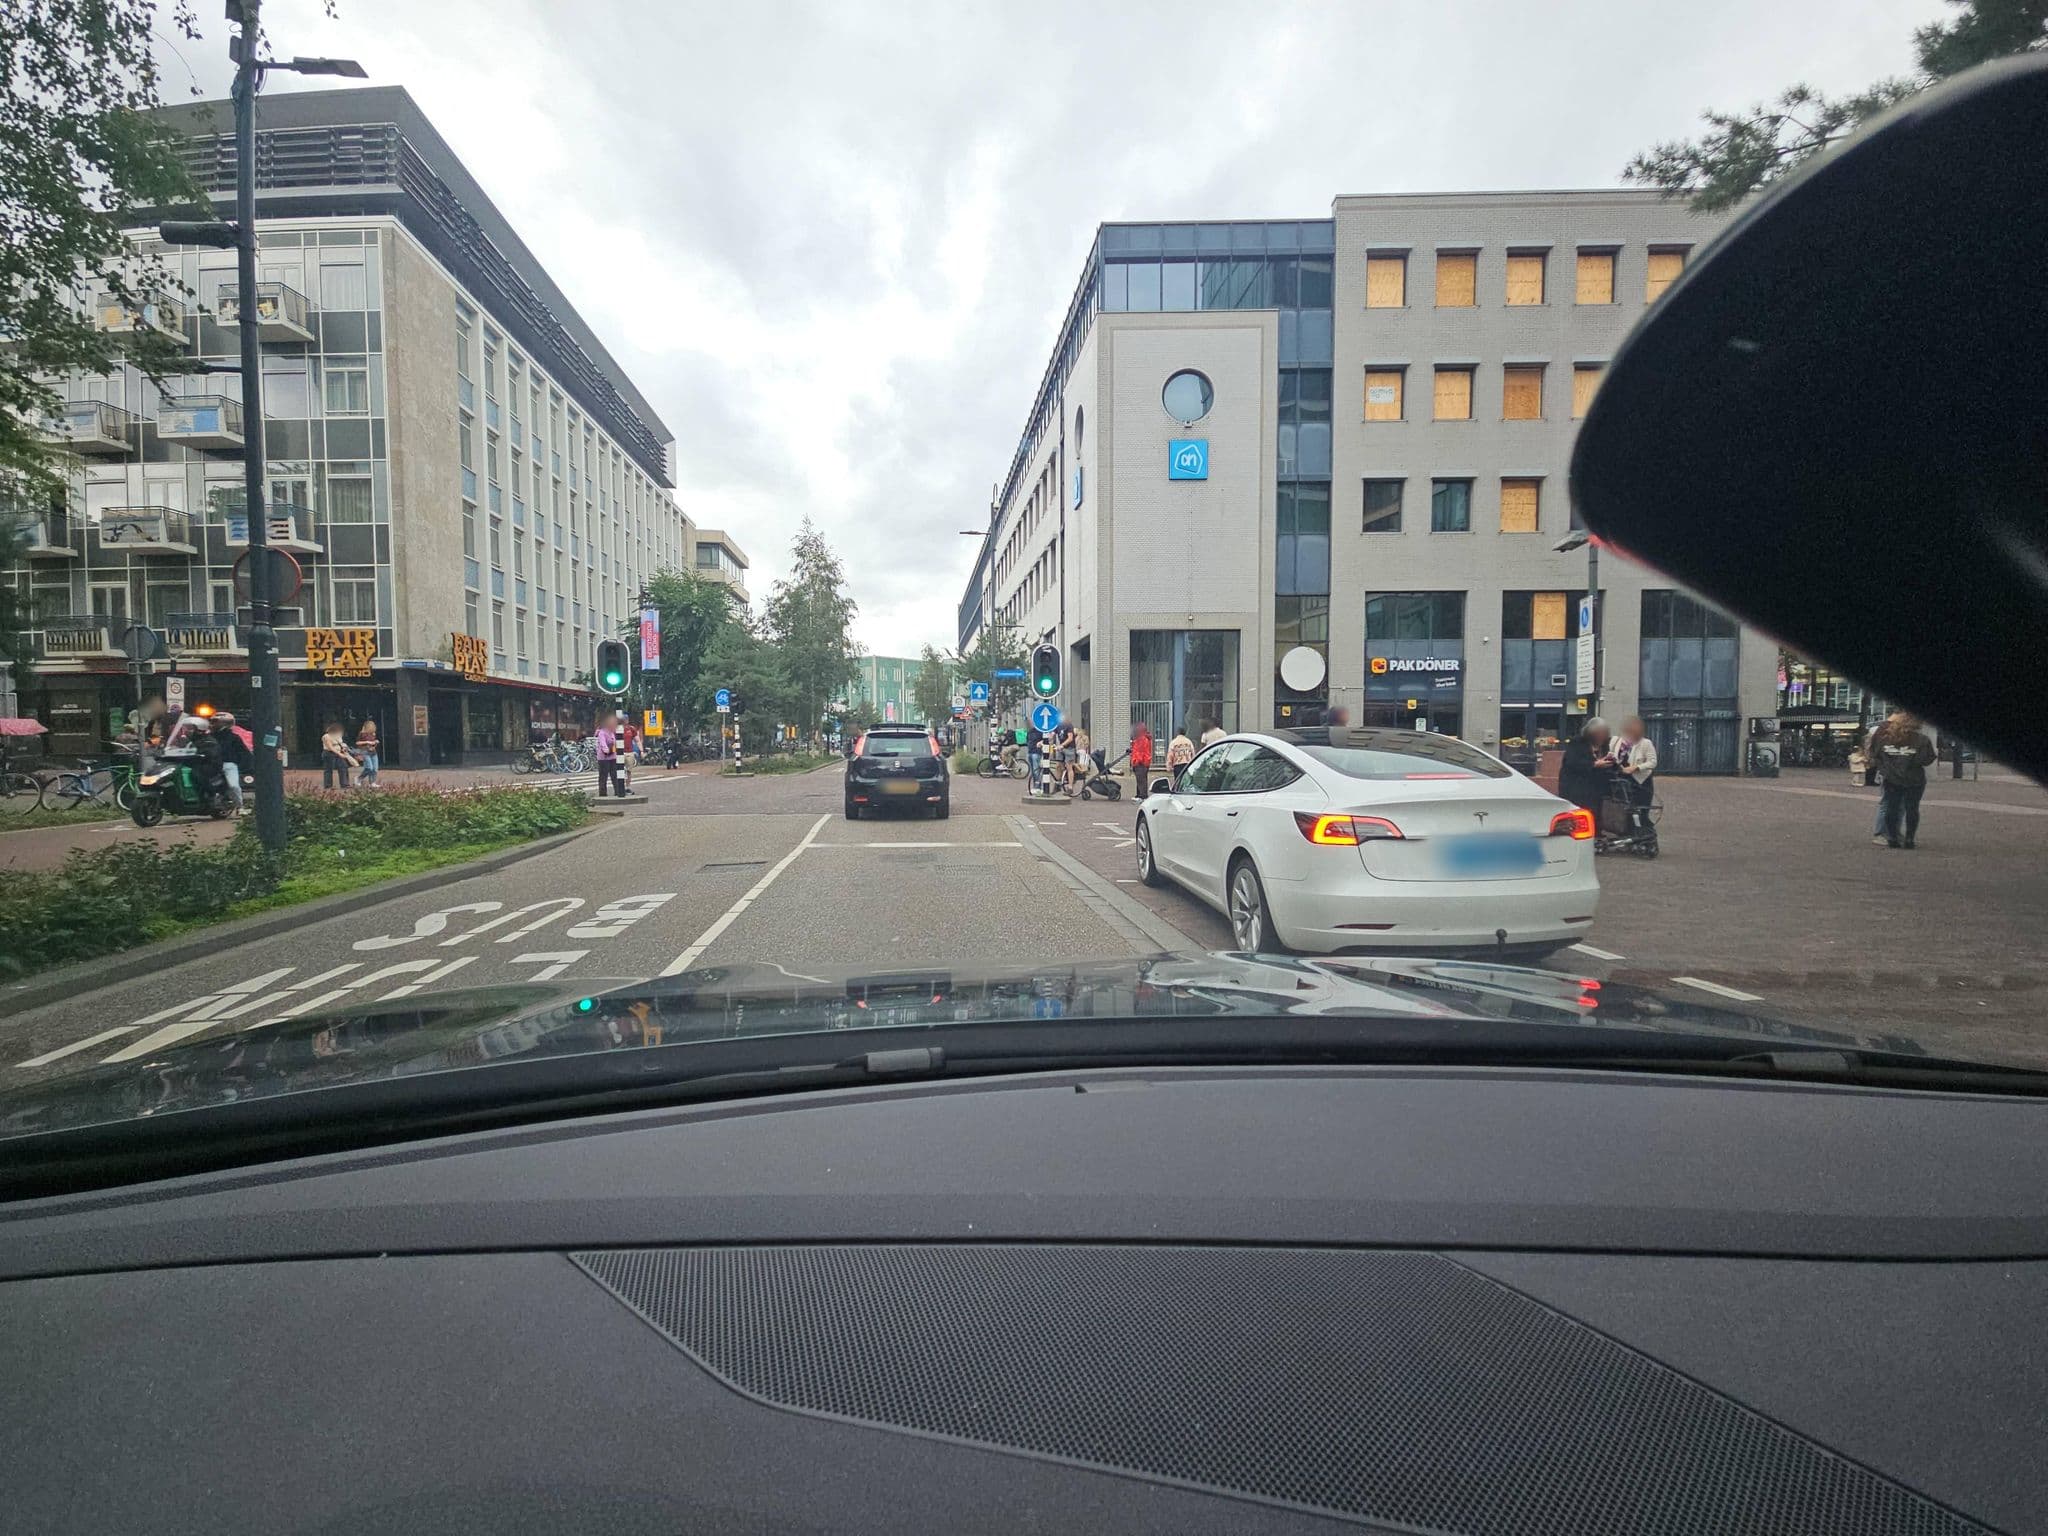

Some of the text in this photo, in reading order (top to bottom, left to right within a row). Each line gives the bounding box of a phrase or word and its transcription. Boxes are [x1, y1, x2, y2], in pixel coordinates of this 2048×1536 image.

[305, 628, 376, 649] FAIR
[451, 632, 488, 658] FAIR
[306, 648, 377, 670] PLAY
[453, 650, 488, 675] PLAY
[1389, 656, 1460, 671] PAK DÖNER
[324, 668, 372, 678] CASINO
[464, 673, 488, 683] CASINO
[352, 893, 678, 950] BUS
